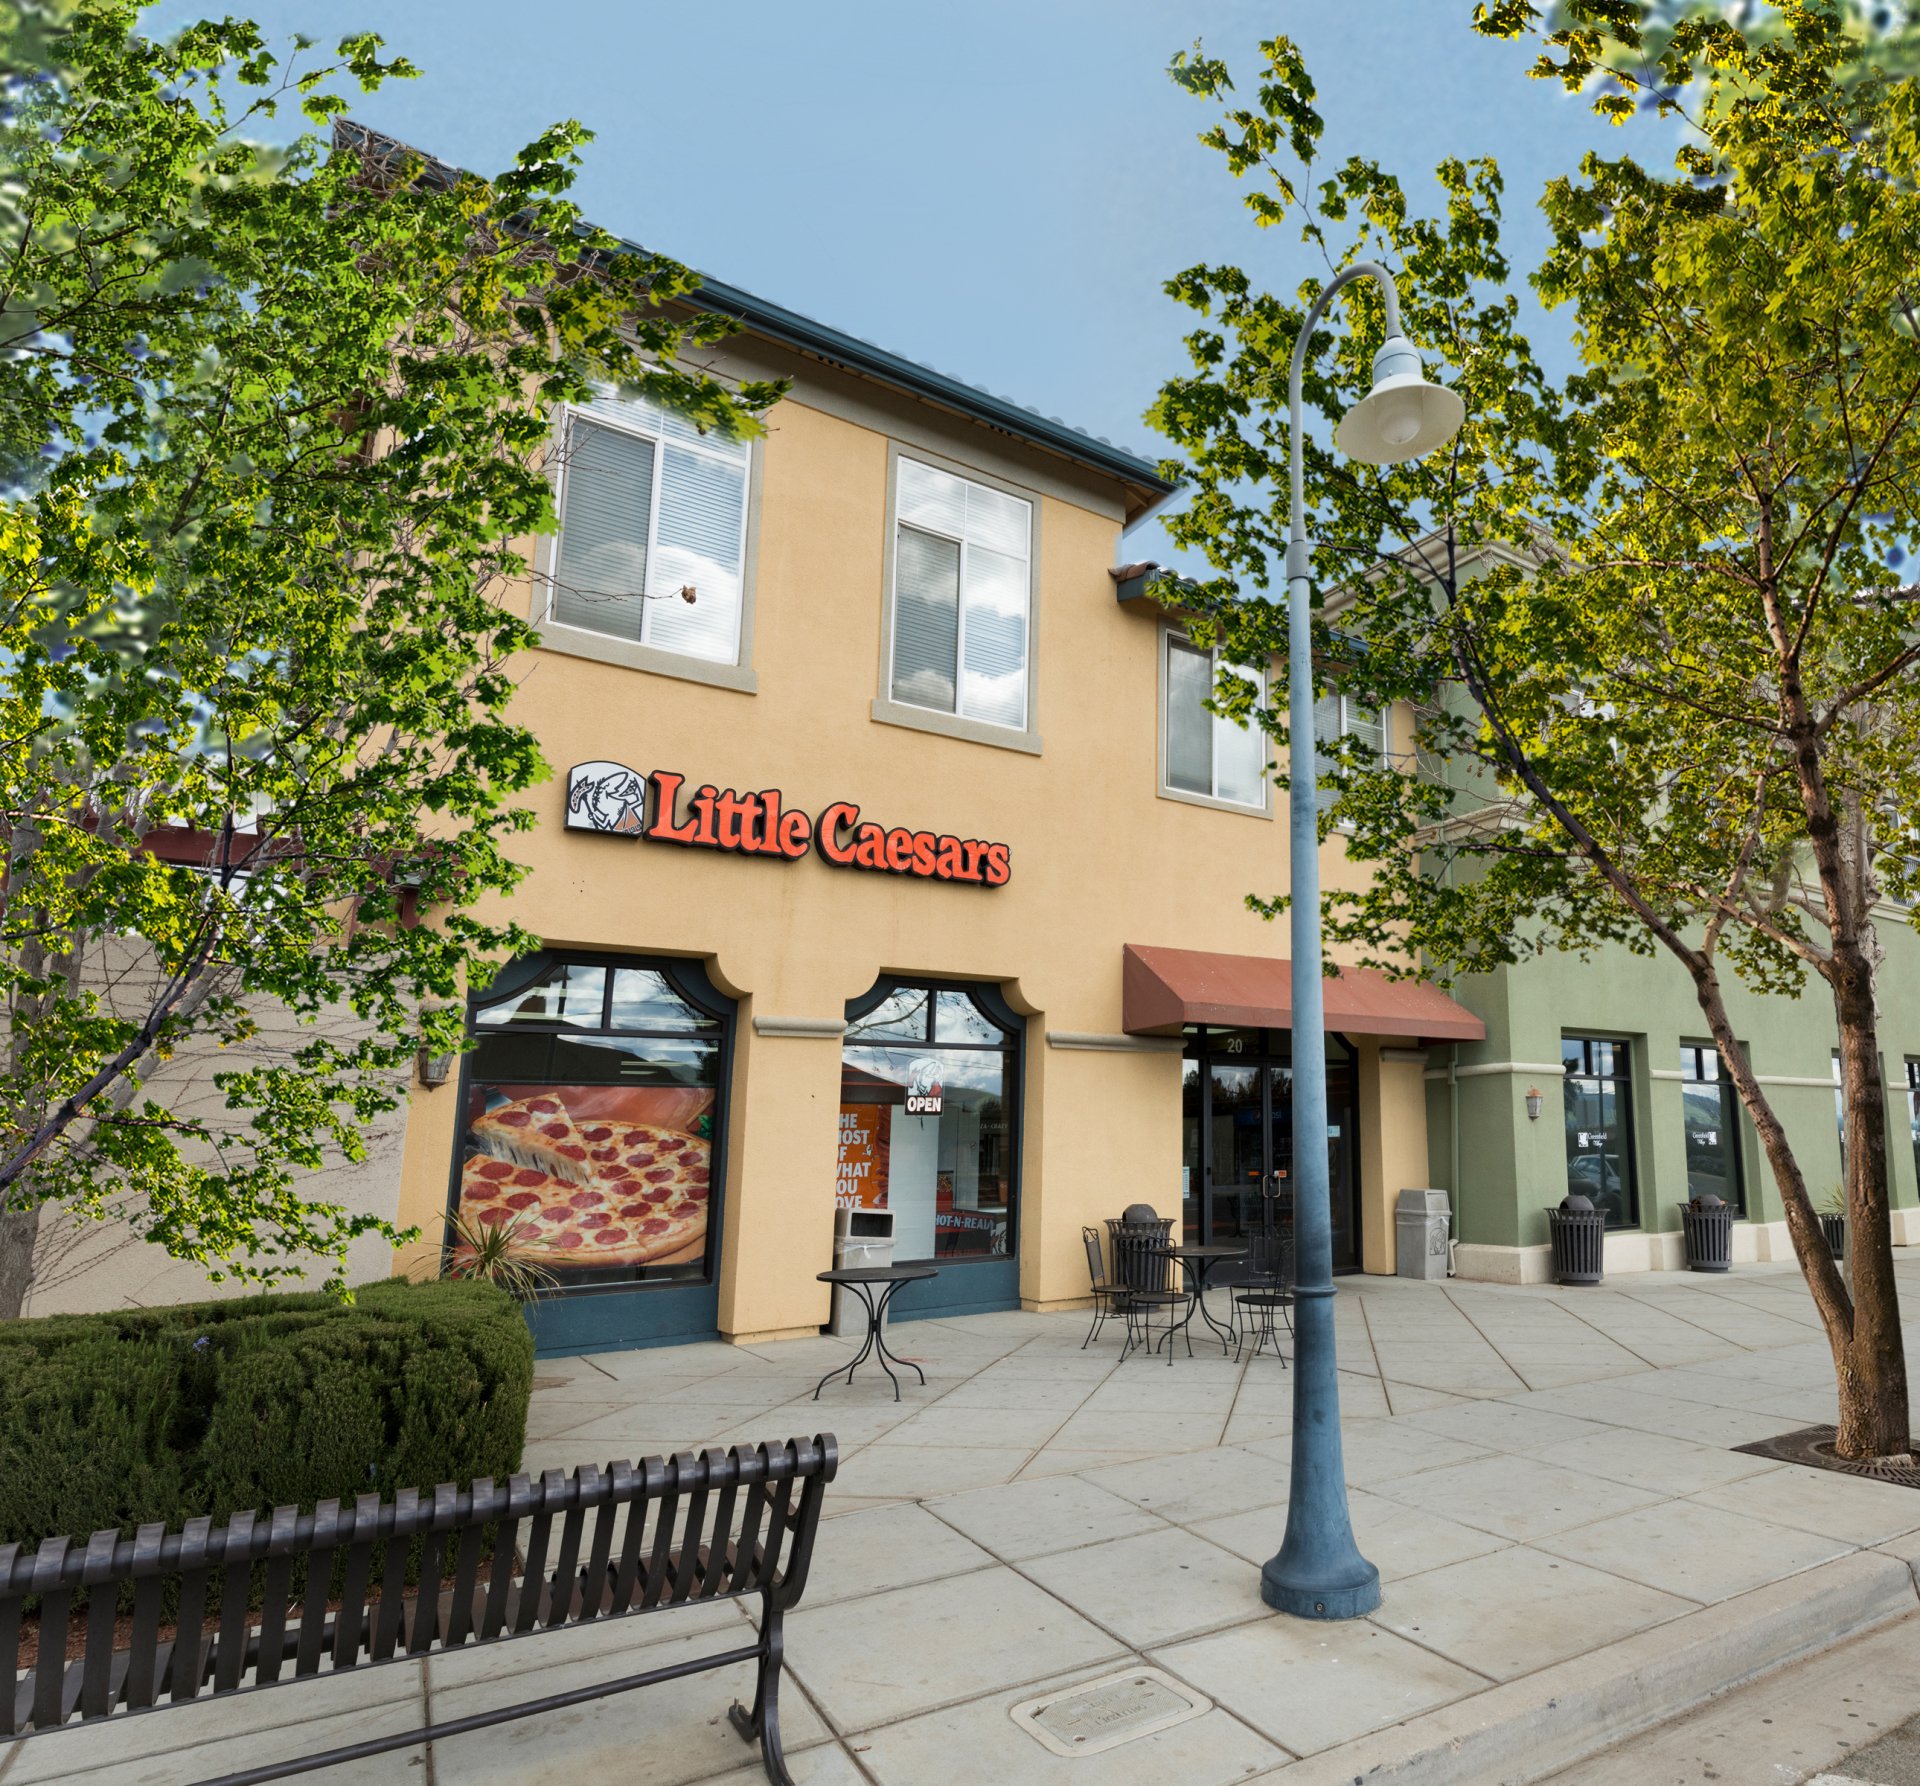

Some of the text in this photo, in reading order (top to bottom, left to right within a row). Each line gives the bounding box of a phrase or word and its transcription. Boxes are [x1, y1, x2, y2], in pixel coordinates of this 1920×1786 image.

[646, 770, 1011, 886] Little Caesars
[1227, 1038, 1242, 1054] 20
[907, 1096, 942, 1112] OPEN
[839, 1113, 858, 1128] HE
[836, 1178, 858, 1195] OU
[835, 1195, 862, 1209] OVE
